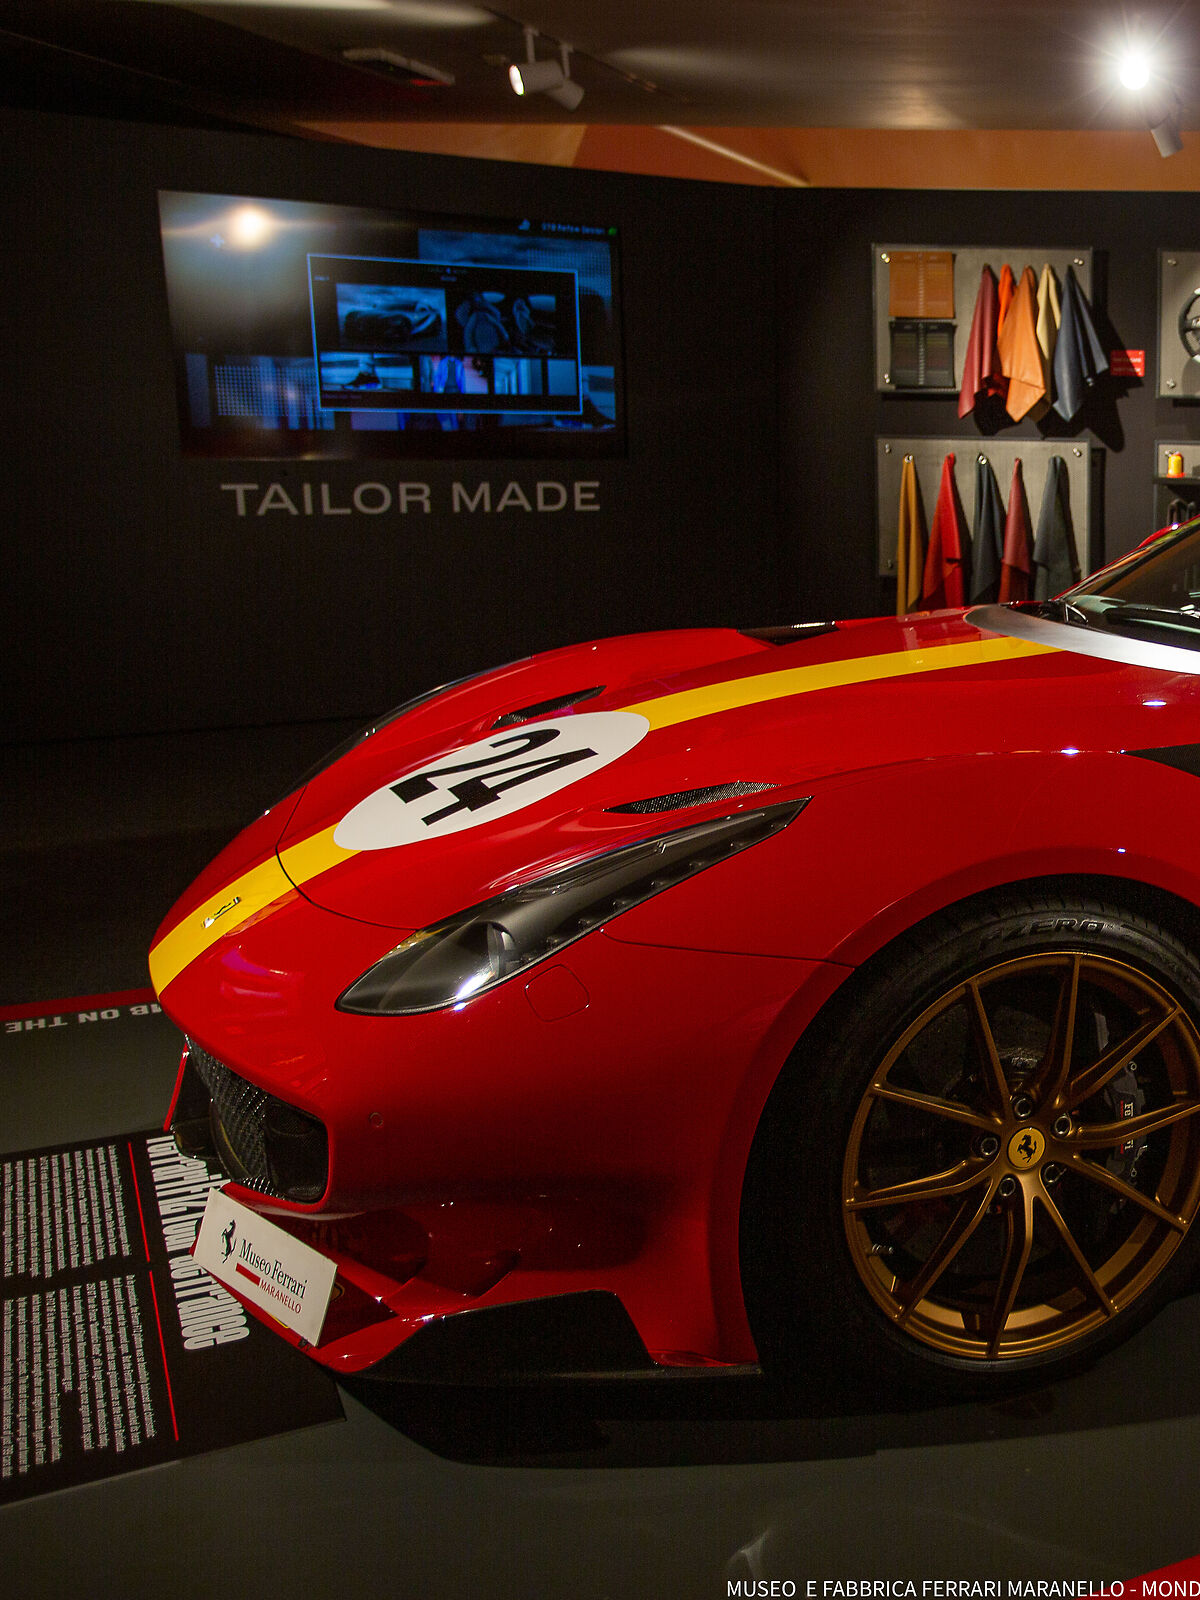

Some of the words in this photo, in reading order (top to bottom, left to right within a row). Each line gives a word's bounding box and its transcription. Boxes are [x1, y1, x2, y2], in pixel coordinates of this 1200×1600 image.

[221, 482, 431, 516] TAILOR
[451, 481, 601, 512] MADE
[389, 729, 598, 826] 24
[5, 1016, 68, 1033] THE
[78, 1008, 121, 1024] ON
[239, 1239, 271, 1275] Museo
[271, 1259, 308, 1299] Ferrari
[260, 1279, 302, 1314] MARANELLO
